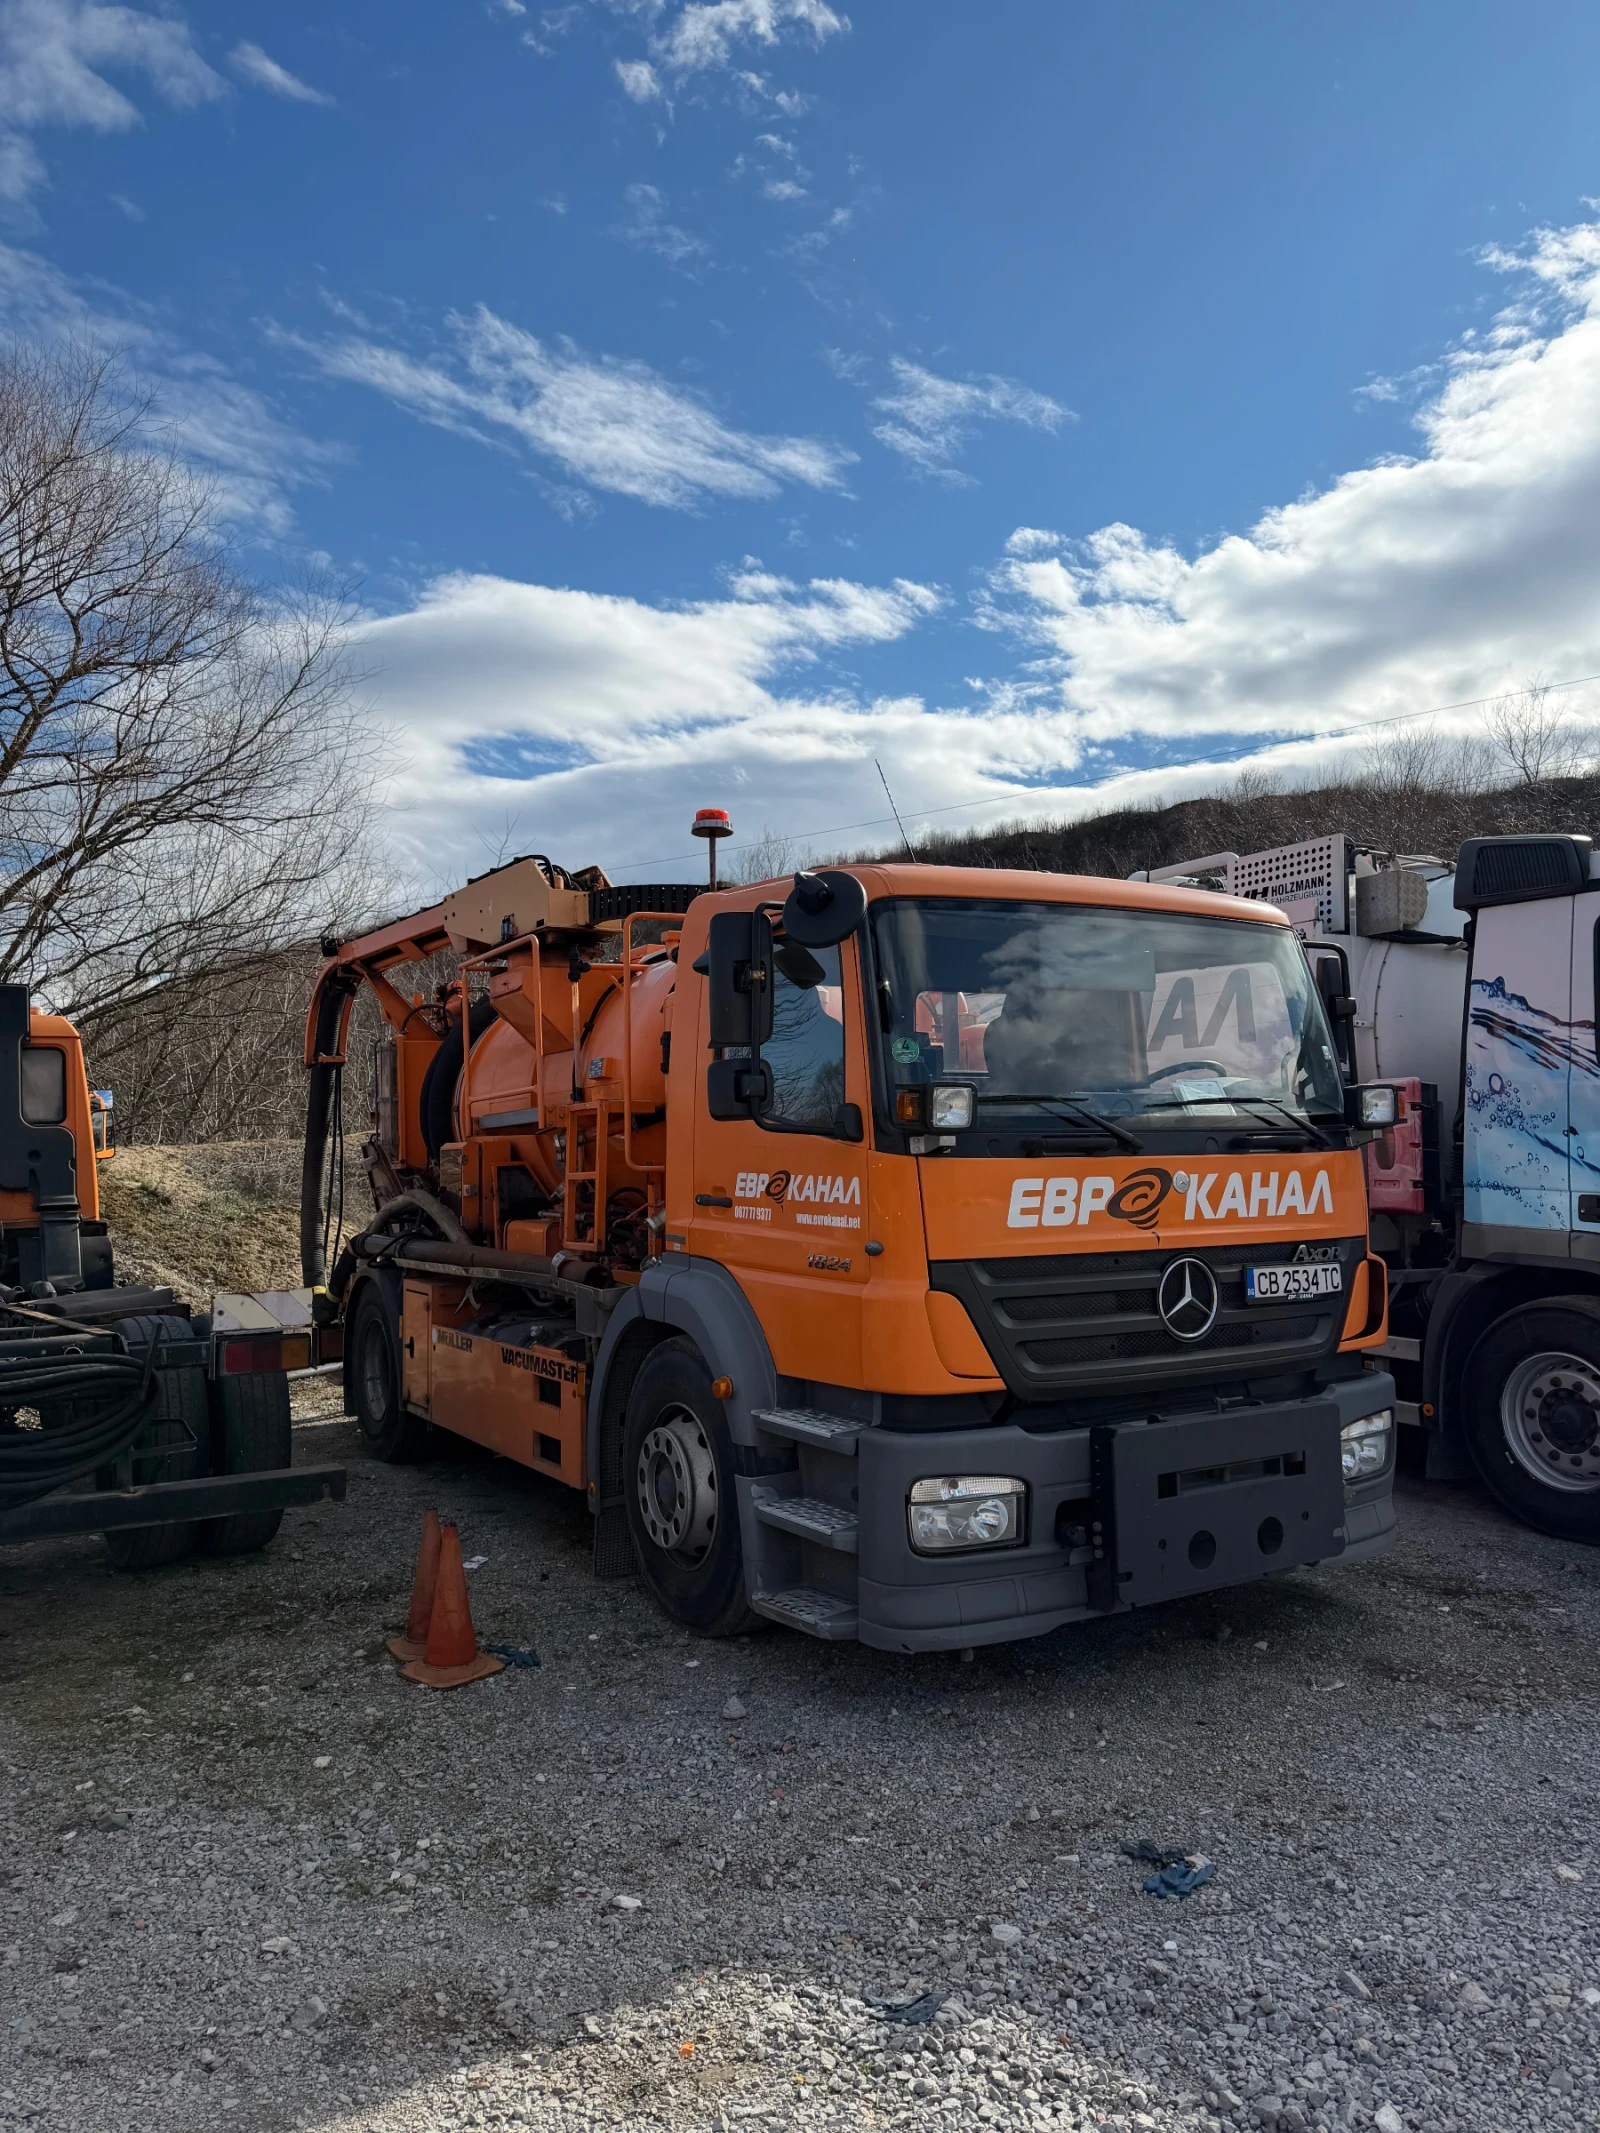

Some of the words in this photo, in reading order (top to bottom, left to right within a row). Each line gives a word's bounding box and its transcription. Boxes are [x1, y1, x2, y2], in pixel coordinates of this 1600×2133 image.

[1271, 875, 1324, 897] HOLZMANN
[807, 1254, 851, 1272] 1824
[1283, 1269, 1319, 1294] 2534
[437, 1328, 473, 1353] MÜLLER
[501, 1347, 578, 1384] VACUMASTER
